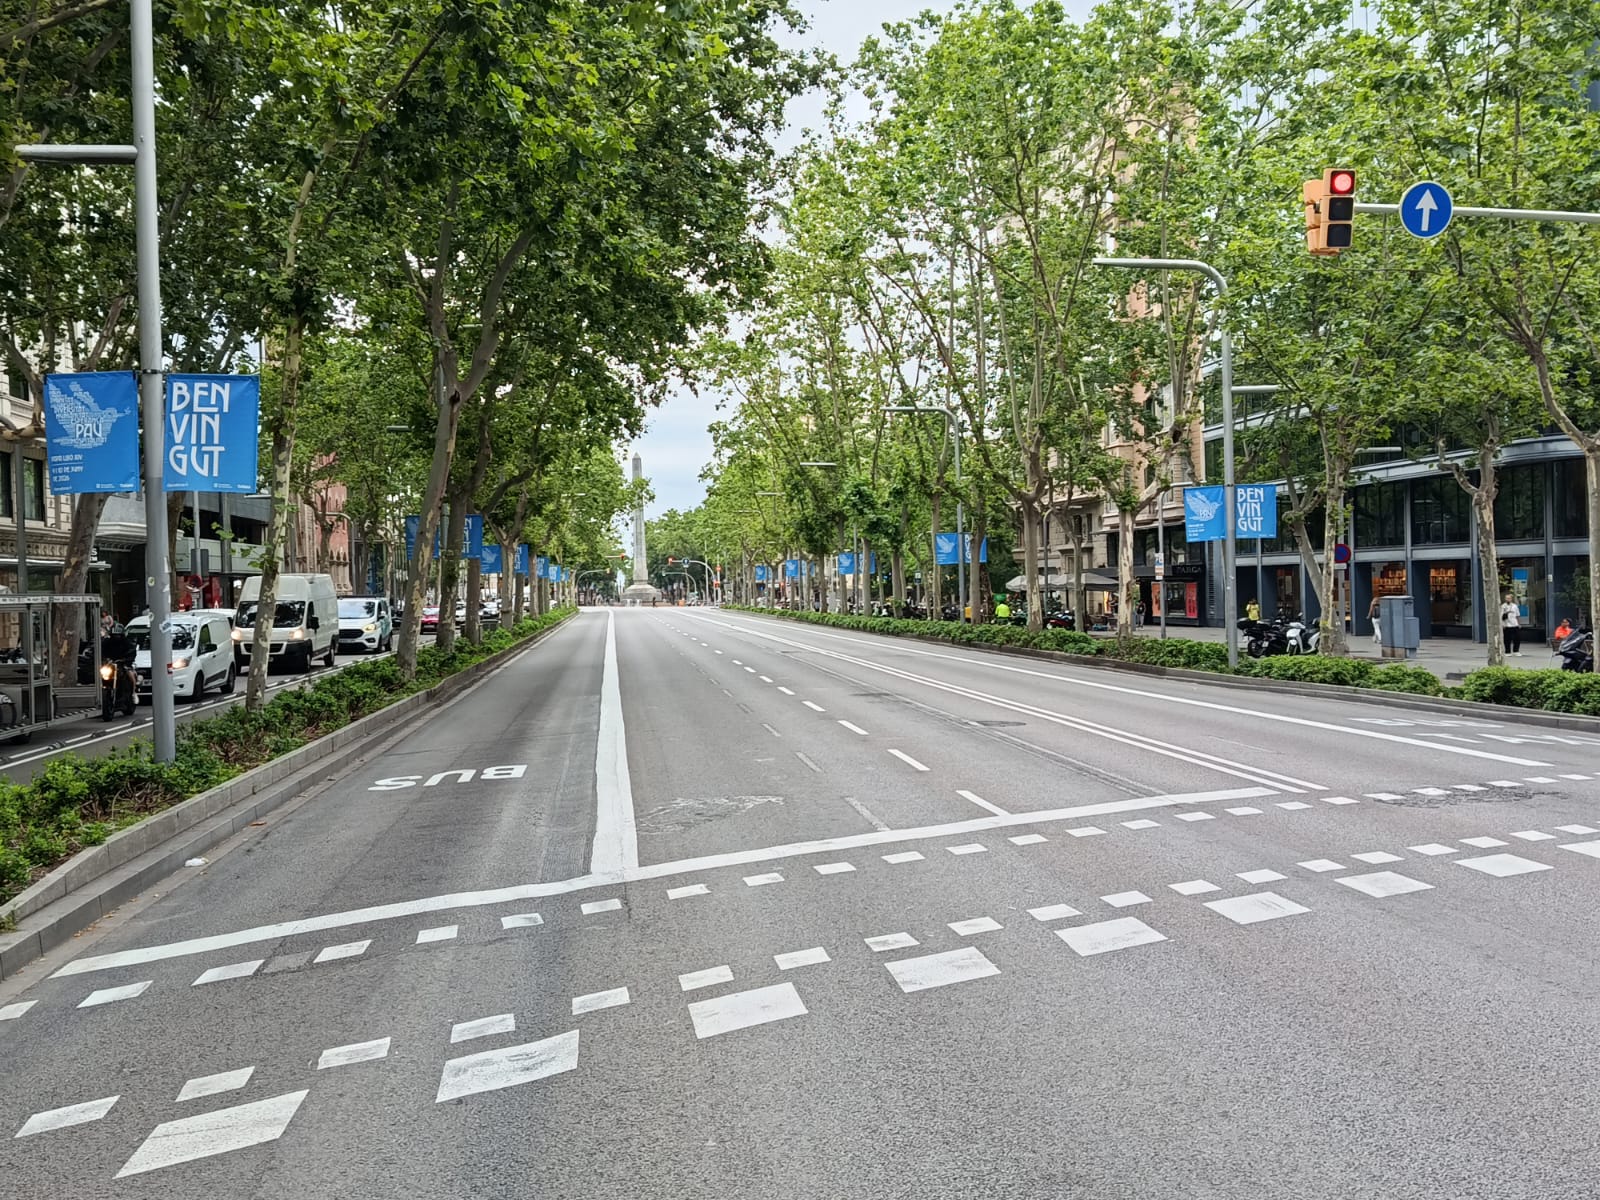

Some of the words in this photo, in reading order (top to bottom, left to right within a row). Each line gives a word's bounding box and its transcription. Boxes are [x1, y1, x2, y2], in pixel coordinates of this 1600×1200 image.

[171, 382, 230, 413] BEN
[75, 423, 102, 438] PAU
[169, 413, 220, 445] VIN
[168, 445, 226, 477] GUT
[1237, 487, 1264, 503] BEN
[1237, 502, 1261, 517] VIN
[1237, 516, 1264, 532] GUT
[1348, 717, 1505, 728] BUS
[367, 764, 528, 791] BUS
